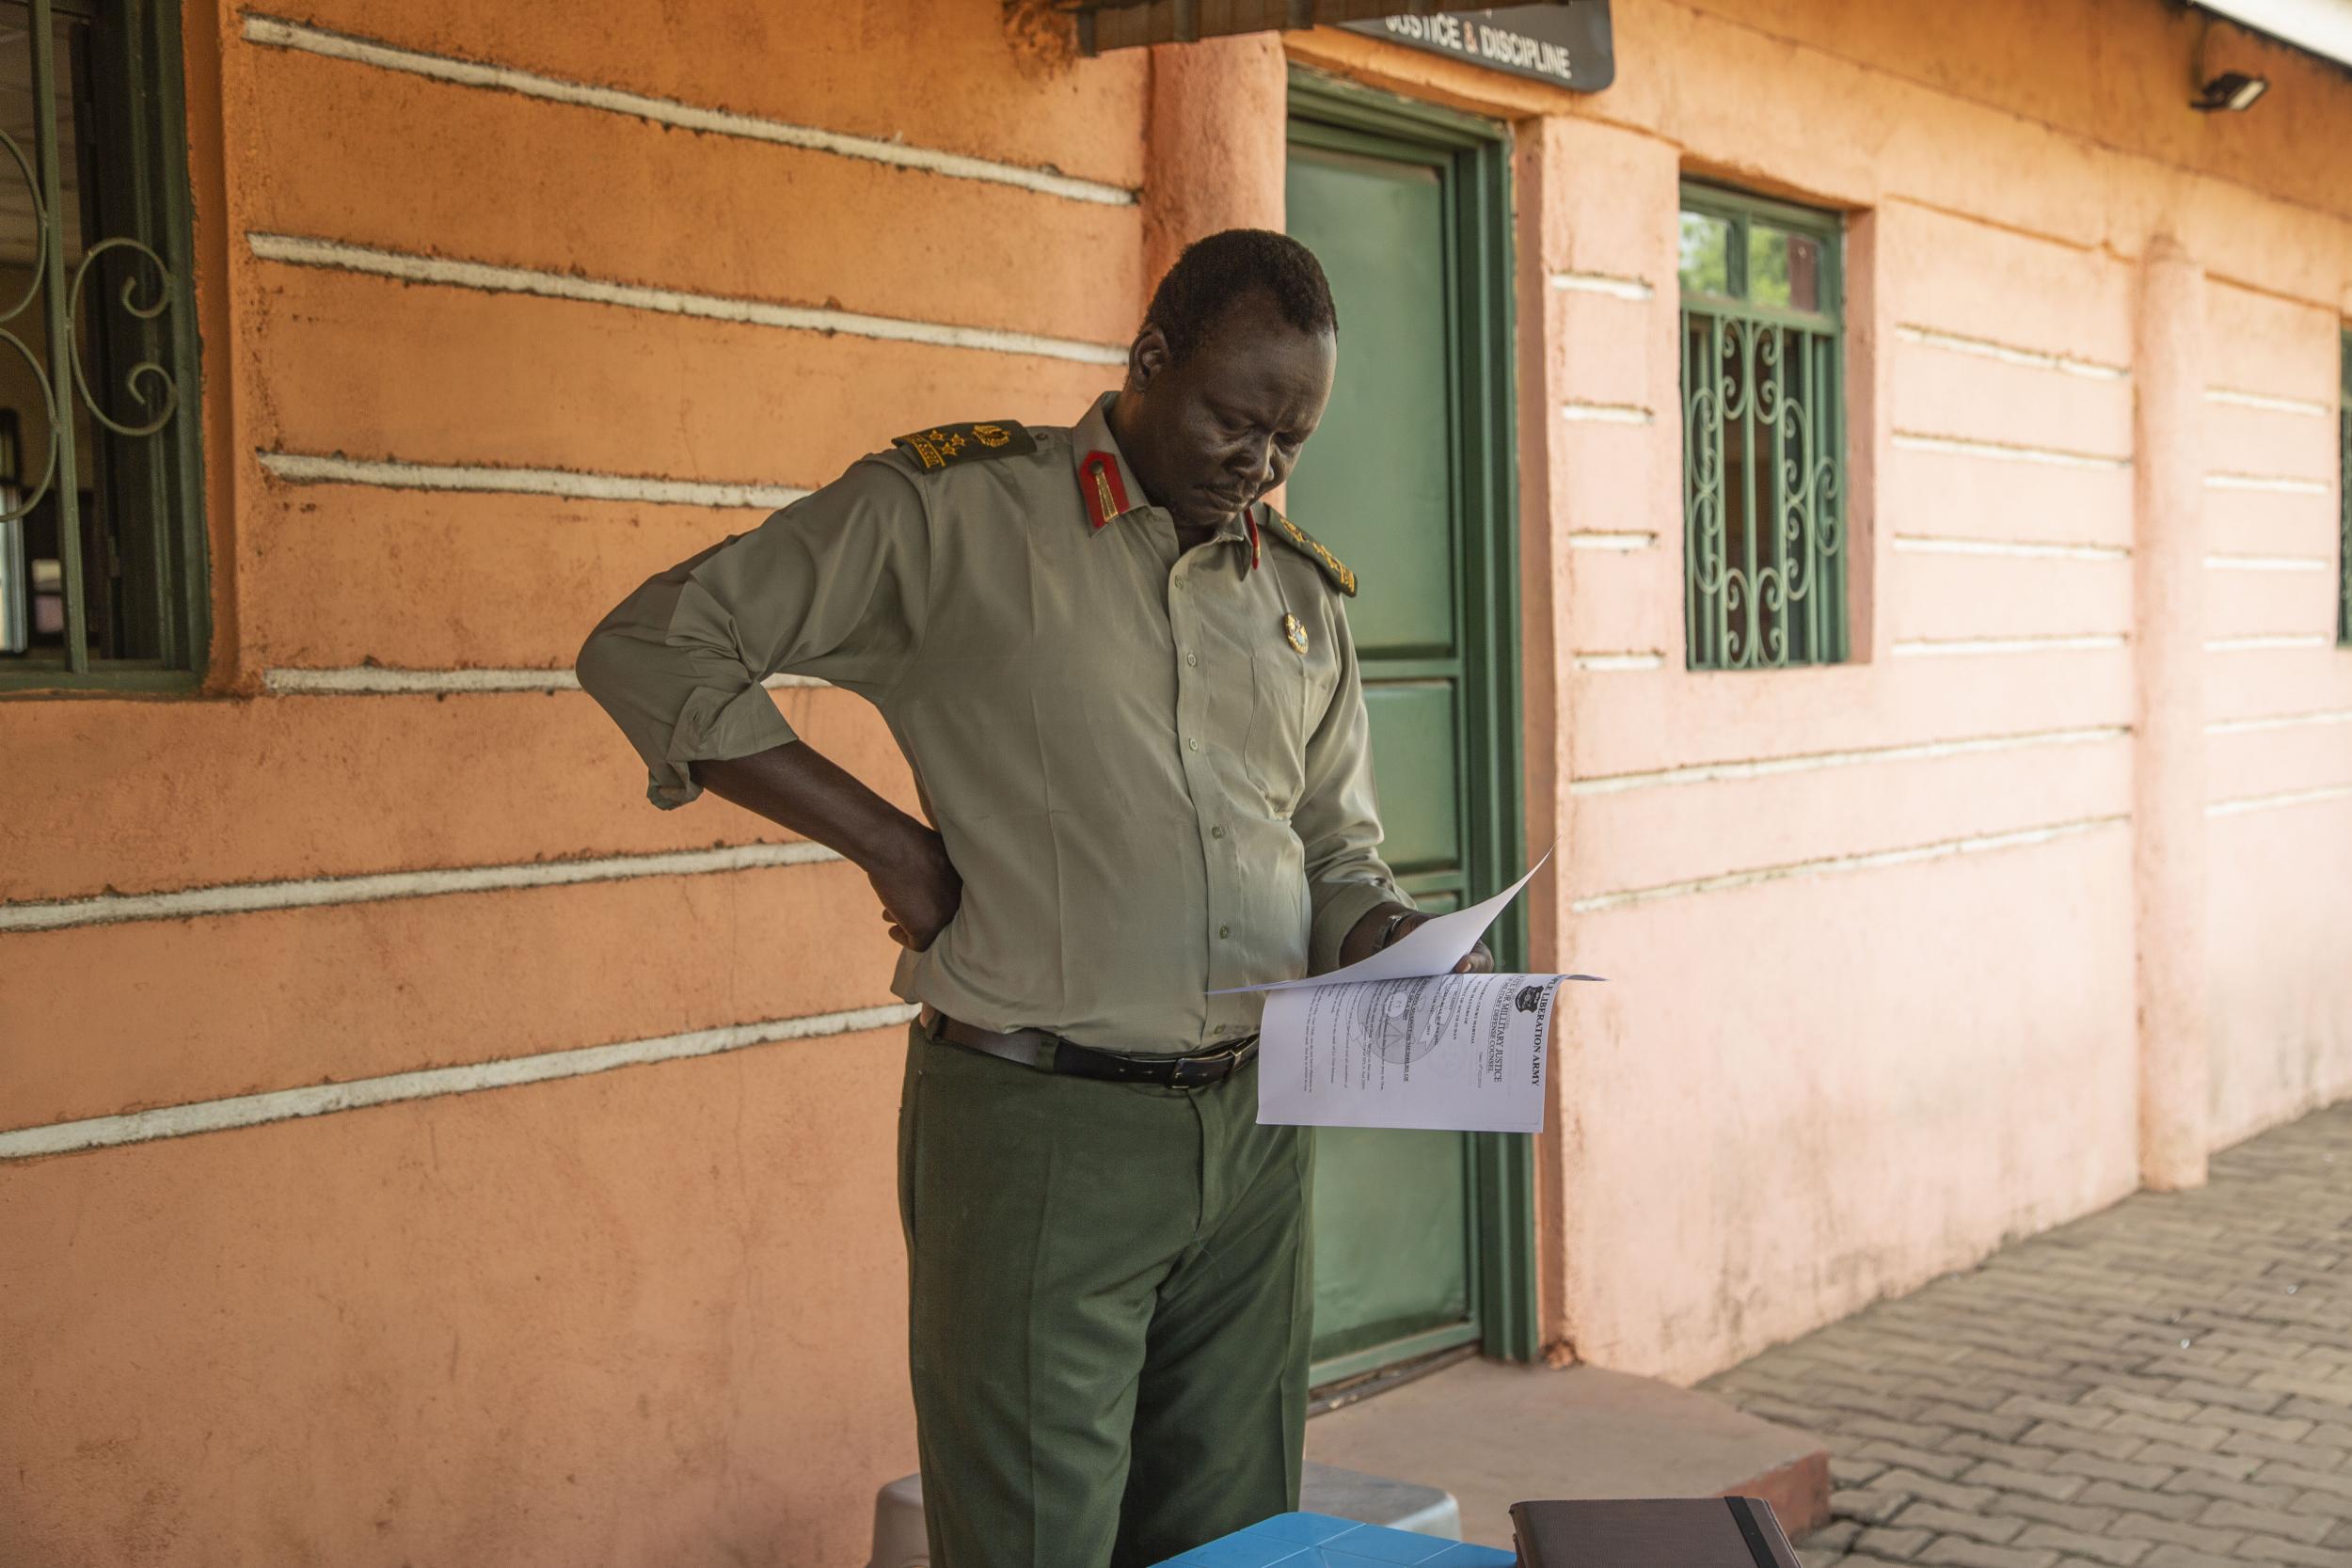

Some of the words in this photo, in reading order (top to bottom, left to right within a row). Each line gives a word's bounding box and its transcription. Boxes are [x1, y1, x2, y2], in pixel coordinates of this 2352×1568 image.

[1386, 12, 1462, 50] JUSTICE
[1481, 24, 1573, 78] DISCIPLINE
[1495, 982, 1509, 1008] MILITARY
[1502, 988, 1515, 1002] FOR
[1490, 1009, 1499, 1040] DEFENSE
[1533, 993, 1549, 1053] LIBERATION
[1494, 1050, 1503, 1083] JUSTICE
[1532, 1055, 1540, 1086] ARMY
